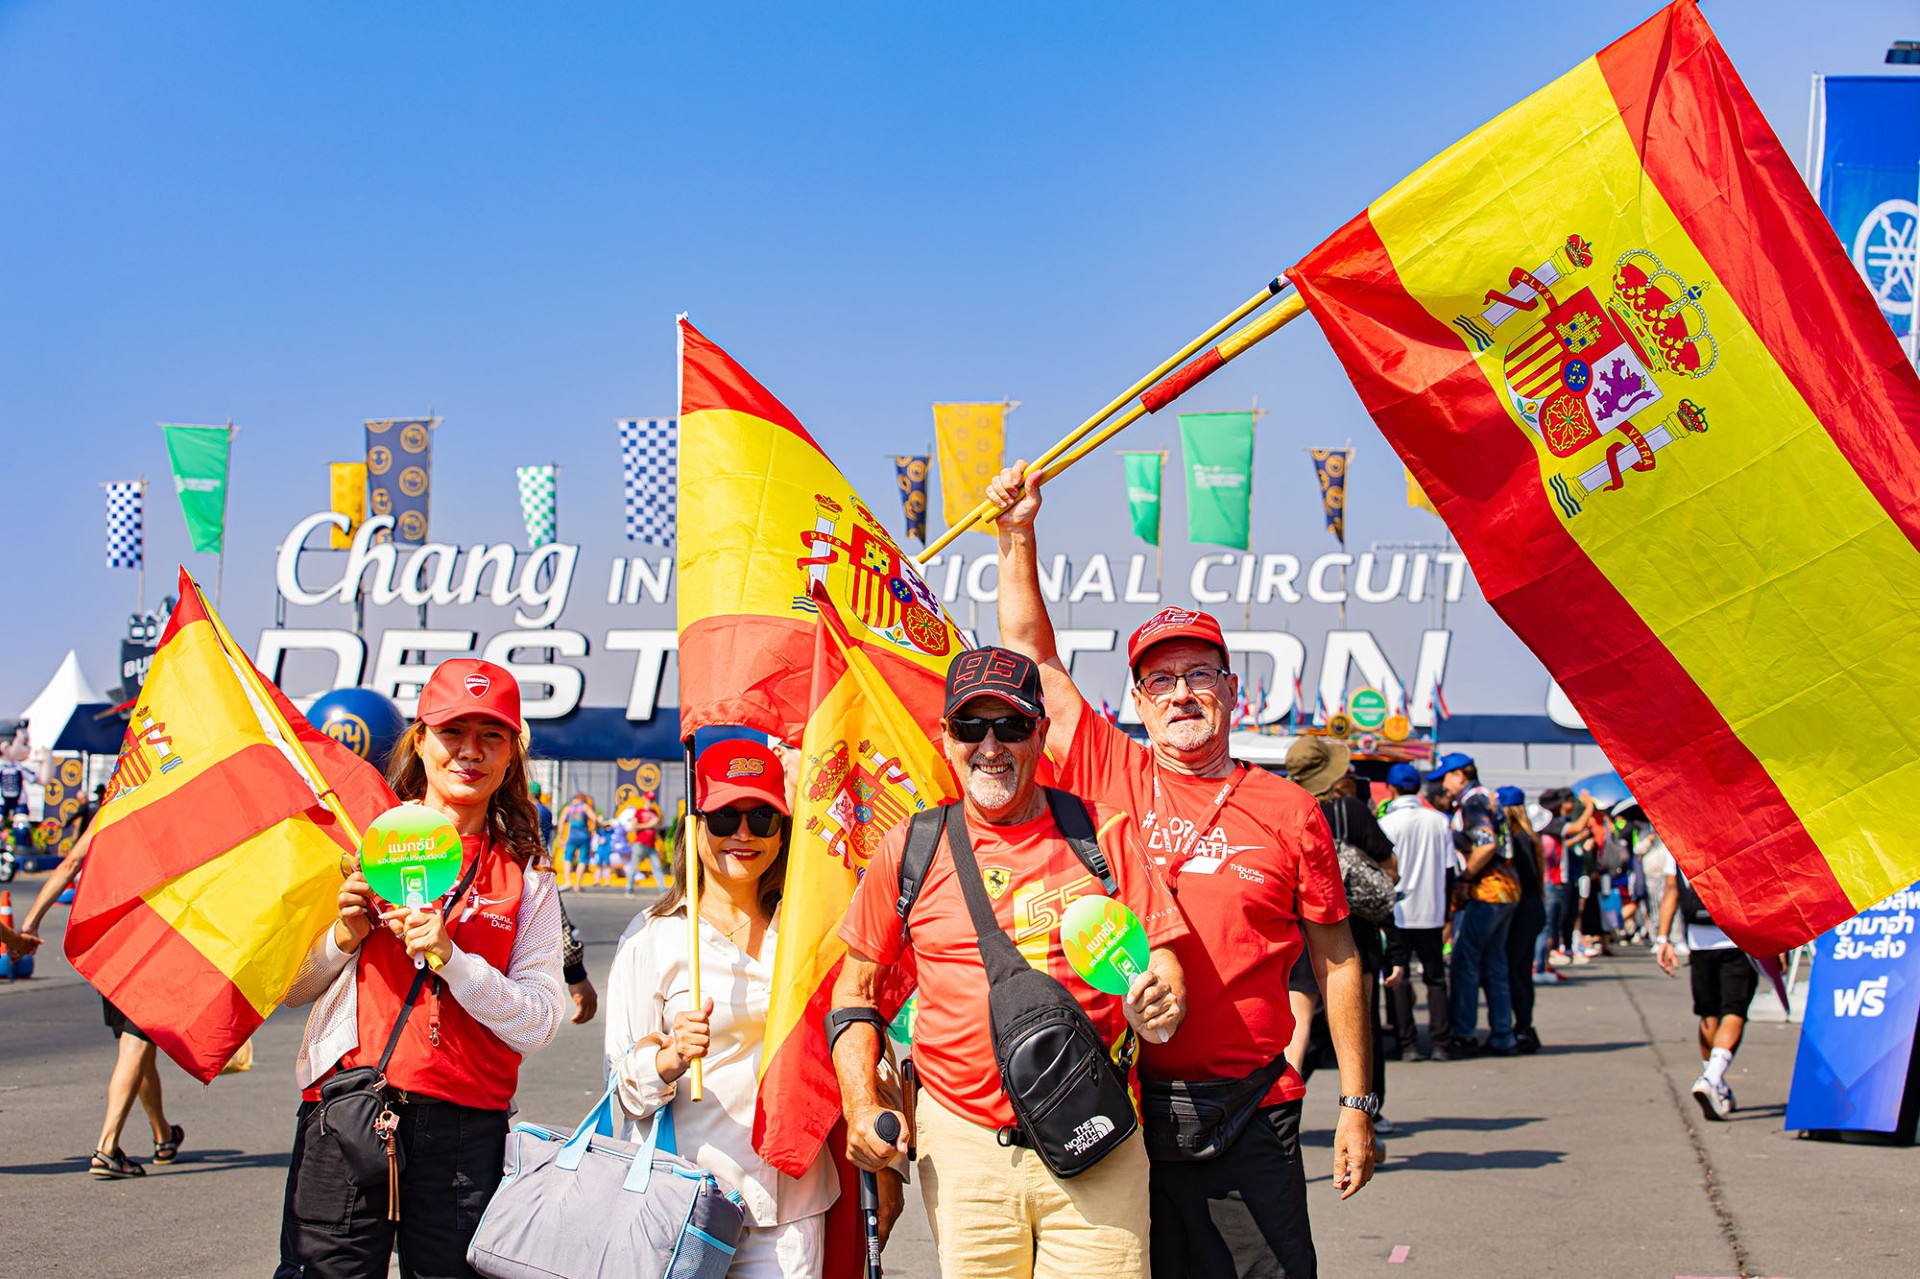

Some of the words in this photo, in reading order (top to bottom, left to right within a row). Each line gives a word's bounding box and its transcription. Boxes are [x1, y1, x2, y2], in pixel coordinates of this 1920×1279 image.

[1521, 273, 1552, 300] PLVS
[1628, 428, 1654, 466] VLTRA
[810, 532, 842, 547] PLVS
[275, 511, 581, 628] Chang
[1189, 552, 1469, 603] CIRCUIT
[953, 649, 1030, 696] 93
[1213, 783, 1231, 805] DUCATI
[1162, 828, 1172, 853] DUCATI
[1182, 830, 1199, 854] DUCATI
[1239, 872, 1265, 885] Ducati
[1833, 934, 1907, 960] รับ-ส่ง
[1833, 975, 1889, 1018] ฟรี
[1063, 1127, 1097, 1151] NORTH
[1073, 1120, 1092, 1136] THE
[1076, 1133, 1100, 1154] FACE
